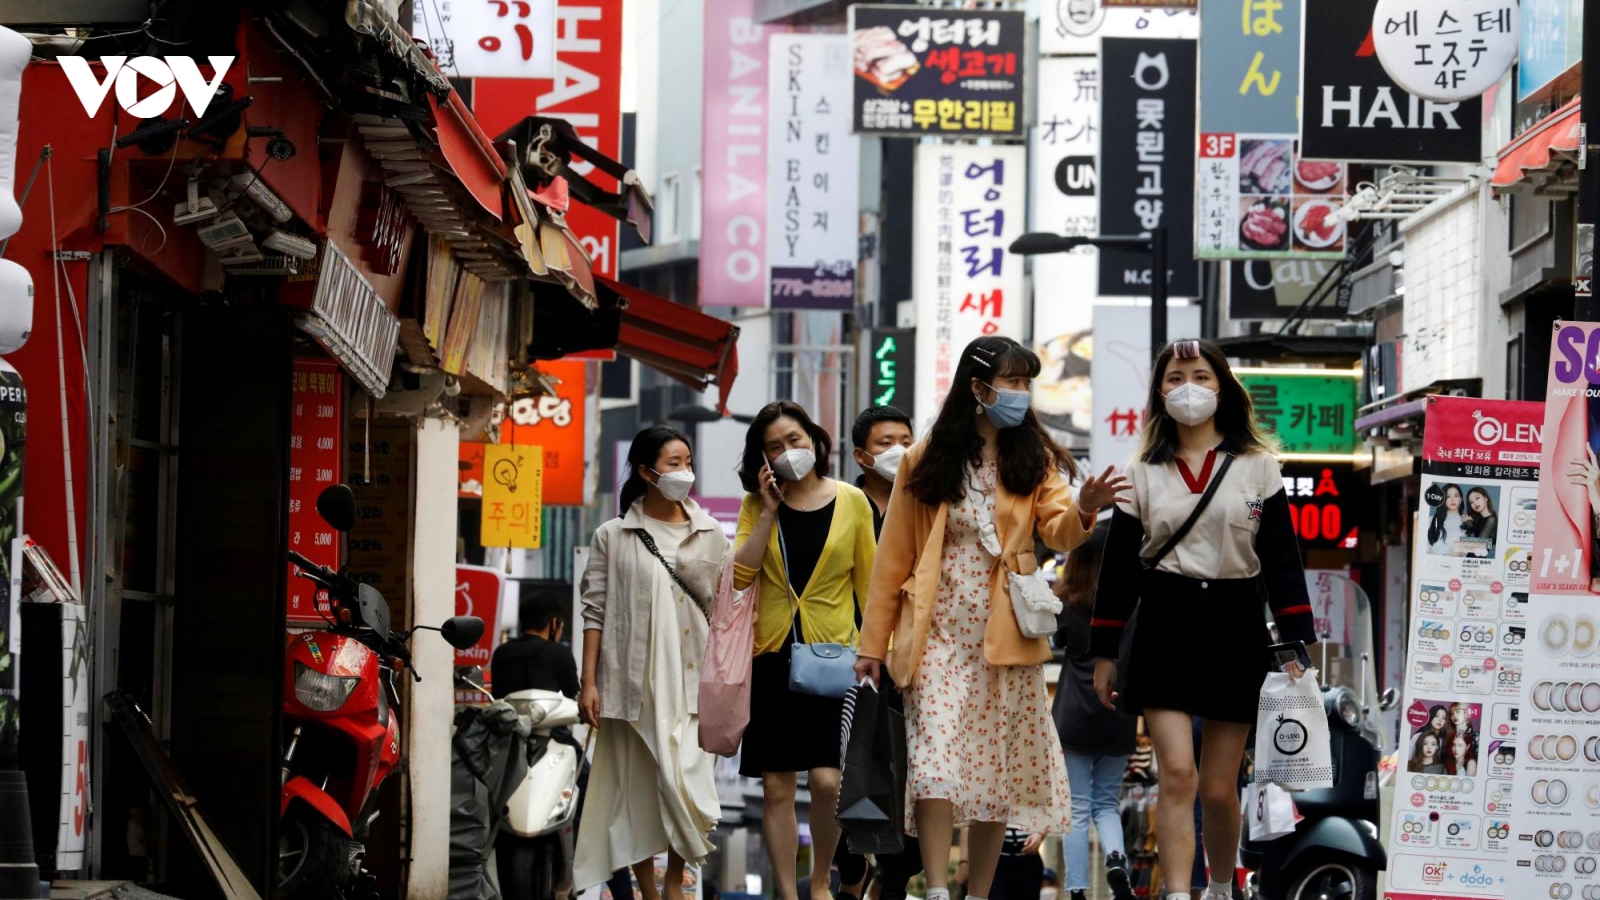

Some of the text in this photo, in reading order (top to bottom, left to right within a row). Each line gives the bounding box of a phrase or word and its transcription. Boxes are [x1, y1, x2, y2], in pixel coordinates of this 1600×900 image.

[897, 16, 1001, 53] 엉터리
[1384, 8, 1512, 37] 에스테
[924, 46, 1017, 85] 생고기
[1414, 39, 1489, 68] エステ
[1434, 70, 1467, 89] 4F
[913, 98, 1016, 131] 무한리필
[1321, 85, 1462, 130] HAIR
[726, 17, 763, 283] BANILA CO
[785, 43, 803, 257] SKIN EASY
[1205, 136, 1233, 156] 3F
[812, 96, 832, 233] 스킨이지
[1134, 98, 1165, 234] 못된고양
[959, 158, 1004, 335] 엉터리 생
[309, 372, 334, 395] 떡볶이
[1552, 388, 1577, 397] MAKE
[316, 404, 334, 419] 3,000
[1105, 407, 1147, 437] 休
[1290, 403, 1346, 436] 카페
[316, 437, 334, 450] 4,000
[1453, 448, 1475, 460] 최다
[315, 468, 333, 482] 3,000
[1465, 465, 1491, 477] 일회용
[1494, 466, 1530, 478] 칼라렌즈
[488, 502, 529, 534] 주의
[314, 532, 332, 546] 5,000
[1540, 548, 1583, 579] 1+1
[73, 740, 88, 837] 5
[1425, 866, 1442, 876] OK
[1460, 873, 1493, 885] dodo
